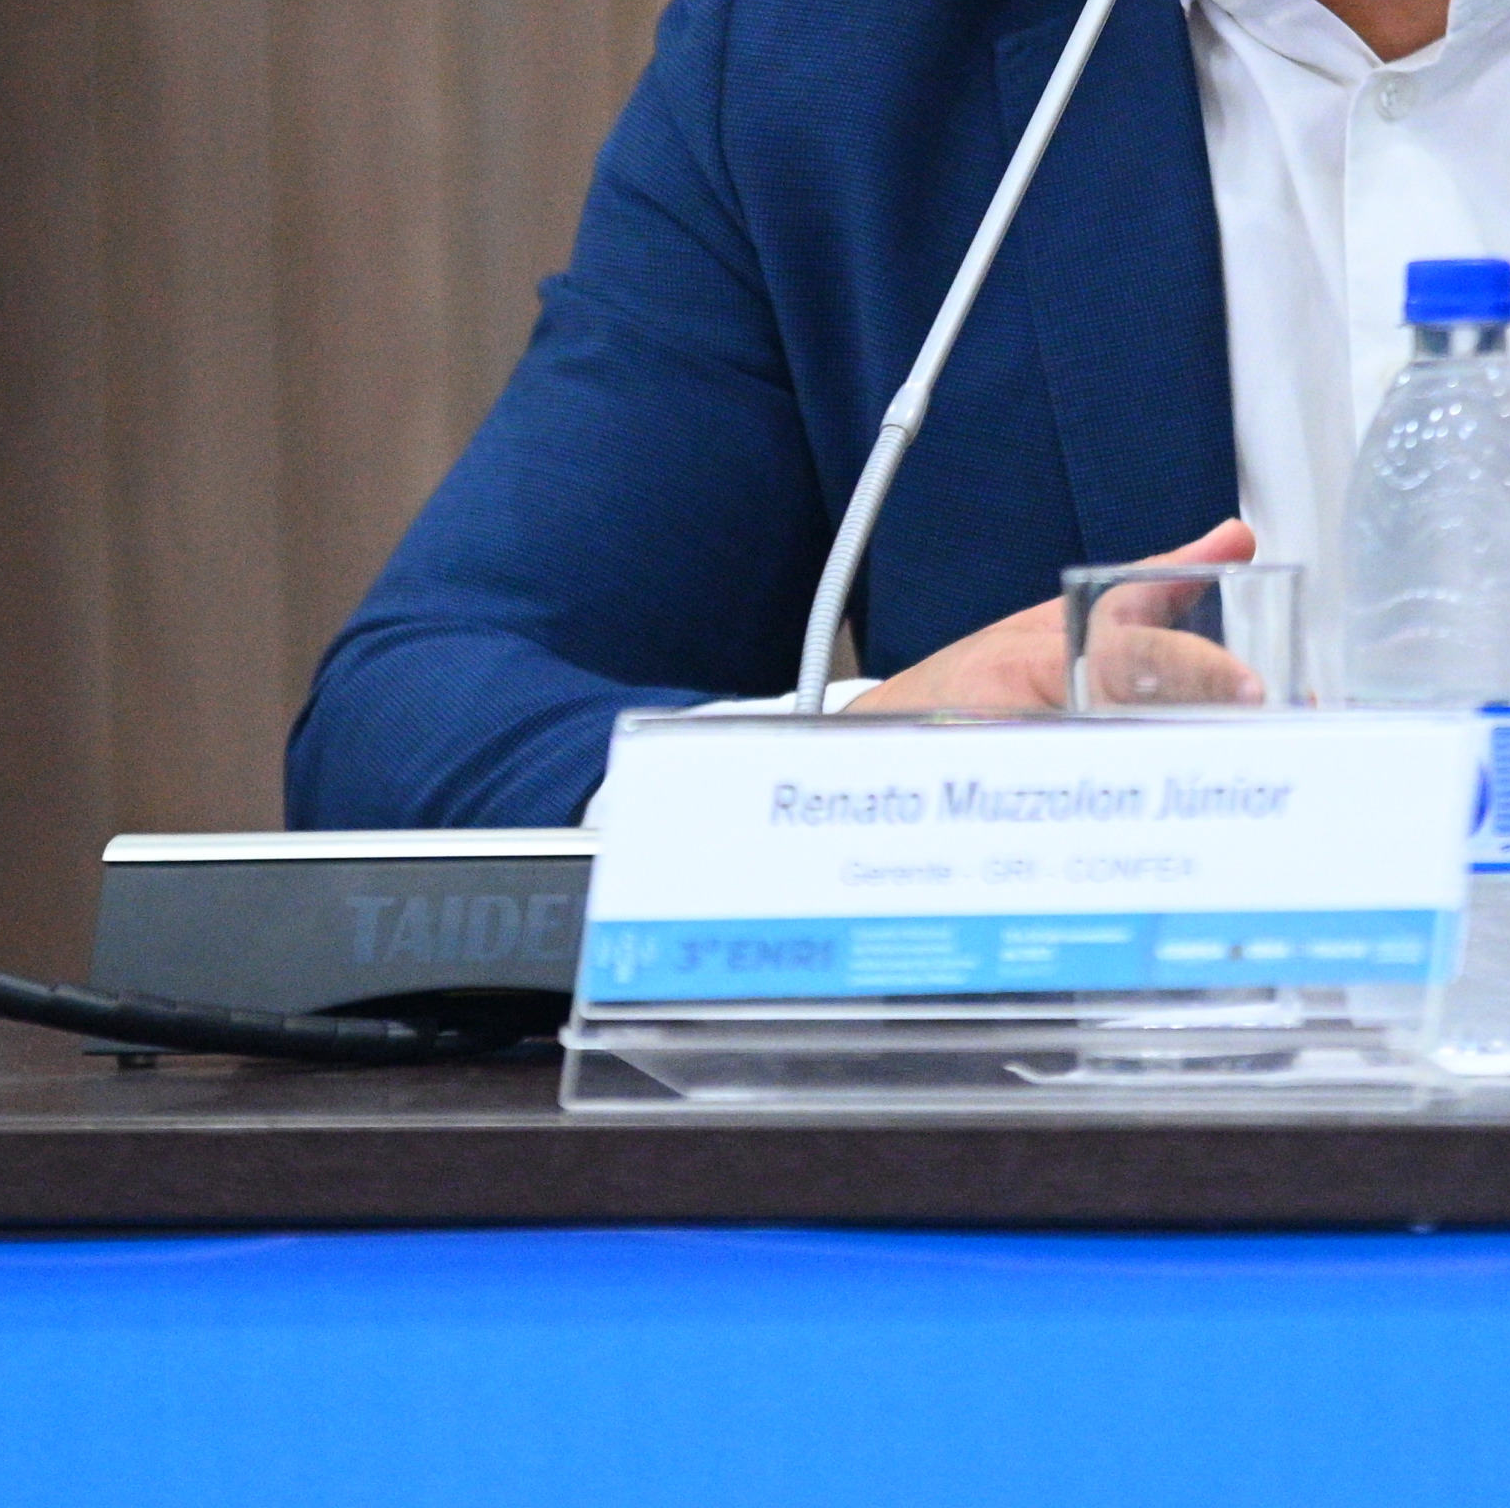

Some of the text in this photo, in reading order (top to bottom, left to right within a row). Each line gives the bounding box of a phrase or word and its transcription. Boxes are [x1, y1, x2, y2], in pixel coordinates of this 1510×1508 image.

[772, 774, 1294, 826] Renato Muzzolon Júnior
